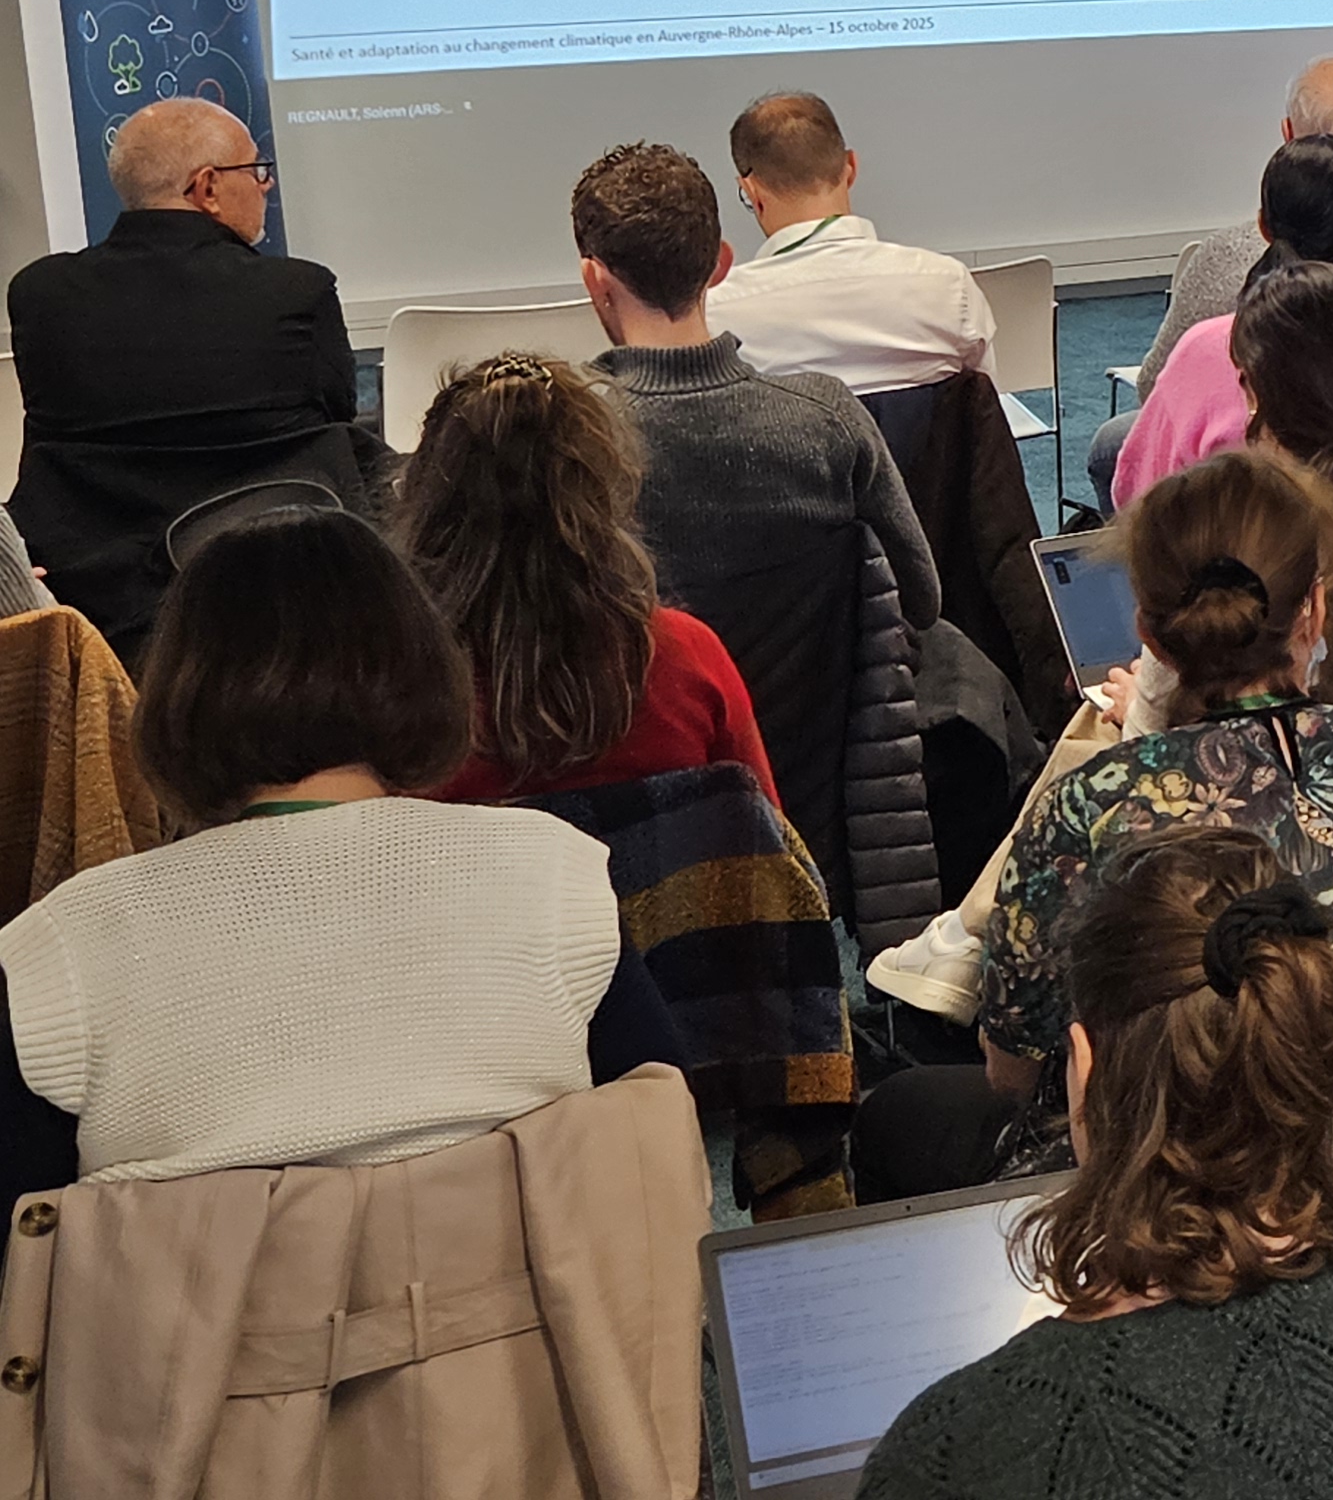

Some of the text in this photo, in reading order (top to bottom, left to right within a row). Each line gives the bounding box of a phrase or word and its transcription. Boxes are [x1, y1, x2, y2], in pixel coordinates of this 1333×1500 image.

[291, 45, 334, 62] Santé
[339, 46, 354, 60] et
[358, 40, 440, 61] adaptation
[444, 42, 462, 54] au
[465, 36, 555, 55] changement
[559, 31, 633, 51] climatique
[637, 33, 654, 44] en
[658, 23, 813, 46] Auvergne-Rhône-Alpes
[829, 21, 844, 33] 15
[848, 18, 898, 33] octobre
[902, 16, 935, 31] 2025
[287, 108, 361, 124] REGNAULT,
